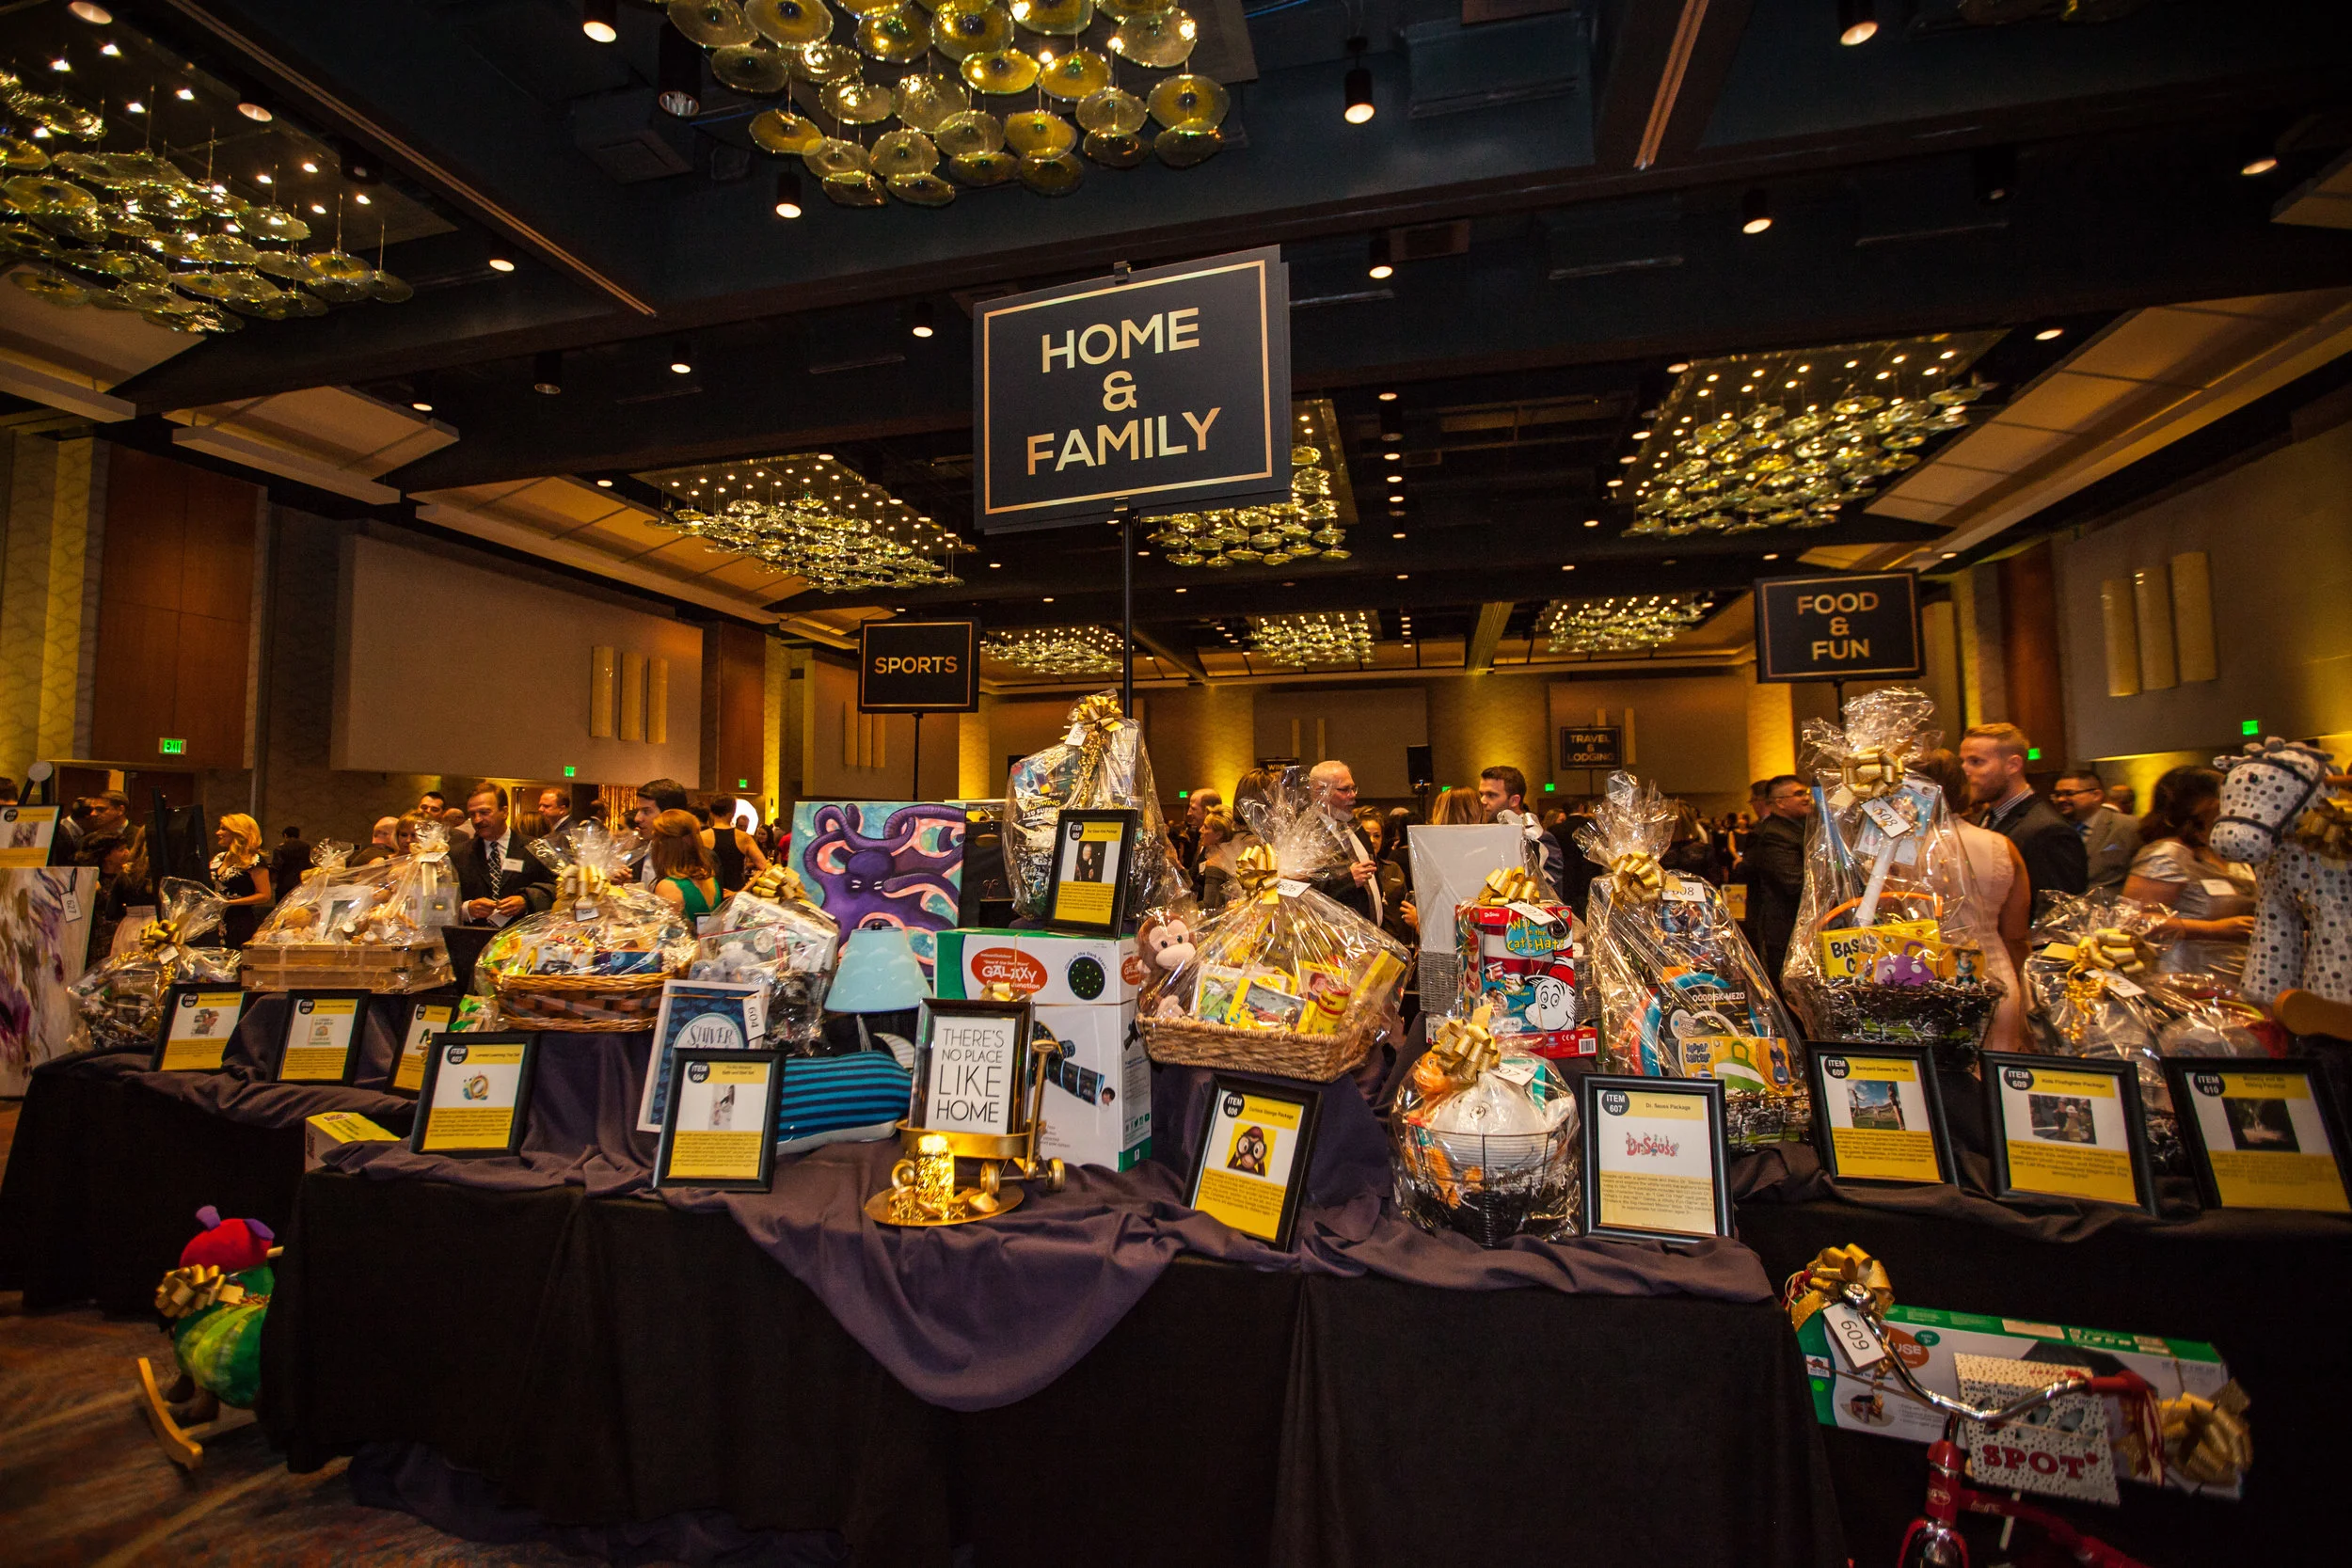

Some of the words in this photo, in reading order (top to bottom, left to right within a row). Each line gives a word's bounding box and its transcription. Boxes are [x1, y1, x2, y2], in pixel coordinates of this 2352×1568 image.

[1041, 307, 1200, 373] HOME
[1103, 371, 1136, 412] &
[1026, 406, 1222, 476] FAMILY
[1797, 591, 1880, 615] FOOD
[1829, 616, 1851, 637] &
[1811, 639, 1871, 661] FUN
[874, 656, 959, 674] SPORTS
[163, 739, 183, 753] EXIT
[1569, 734, 1612, 744] TRAVEL
[1567, 753, 1615, 763] LODGING
[66, 898, 76, 914] 627
[981, 965, 1038, 983] GALAXY
[748, 1006, 759, 1029] 604
[687, 1023, 733, 1046] SHIVER
[943, 1028, 1005, 1049] THERE'S
[942, 1049, 962, 1062] NO
[964, 1049, 1003, 1064] PLACE
[1828, 1059, 1846, 1068] ITEM
[938, 1064, 1002, 1098] LIKE
[2009, 1070, 2029, 1080] ITEM
[2198, 1075, 2219, 1084] ITEM
[2012, 1080, 2028, 1088] 609
[2083, 1081, 2106, 1089] Package
[1227, 1096, 1243, 1106] ITEM
[1606, 1094, 1626, 1103] ITEM
[936, 1099, 1000, 1123] HOME
[1227, 1106, 1238, 1115] 606
[1278, 1111, 1295, 1119] Package
[1609, 1104, 1623, 1113] 607
[1840, 1320, 1870, 1351] 609
[1982, 1444, 2085, 1480] SPOT
